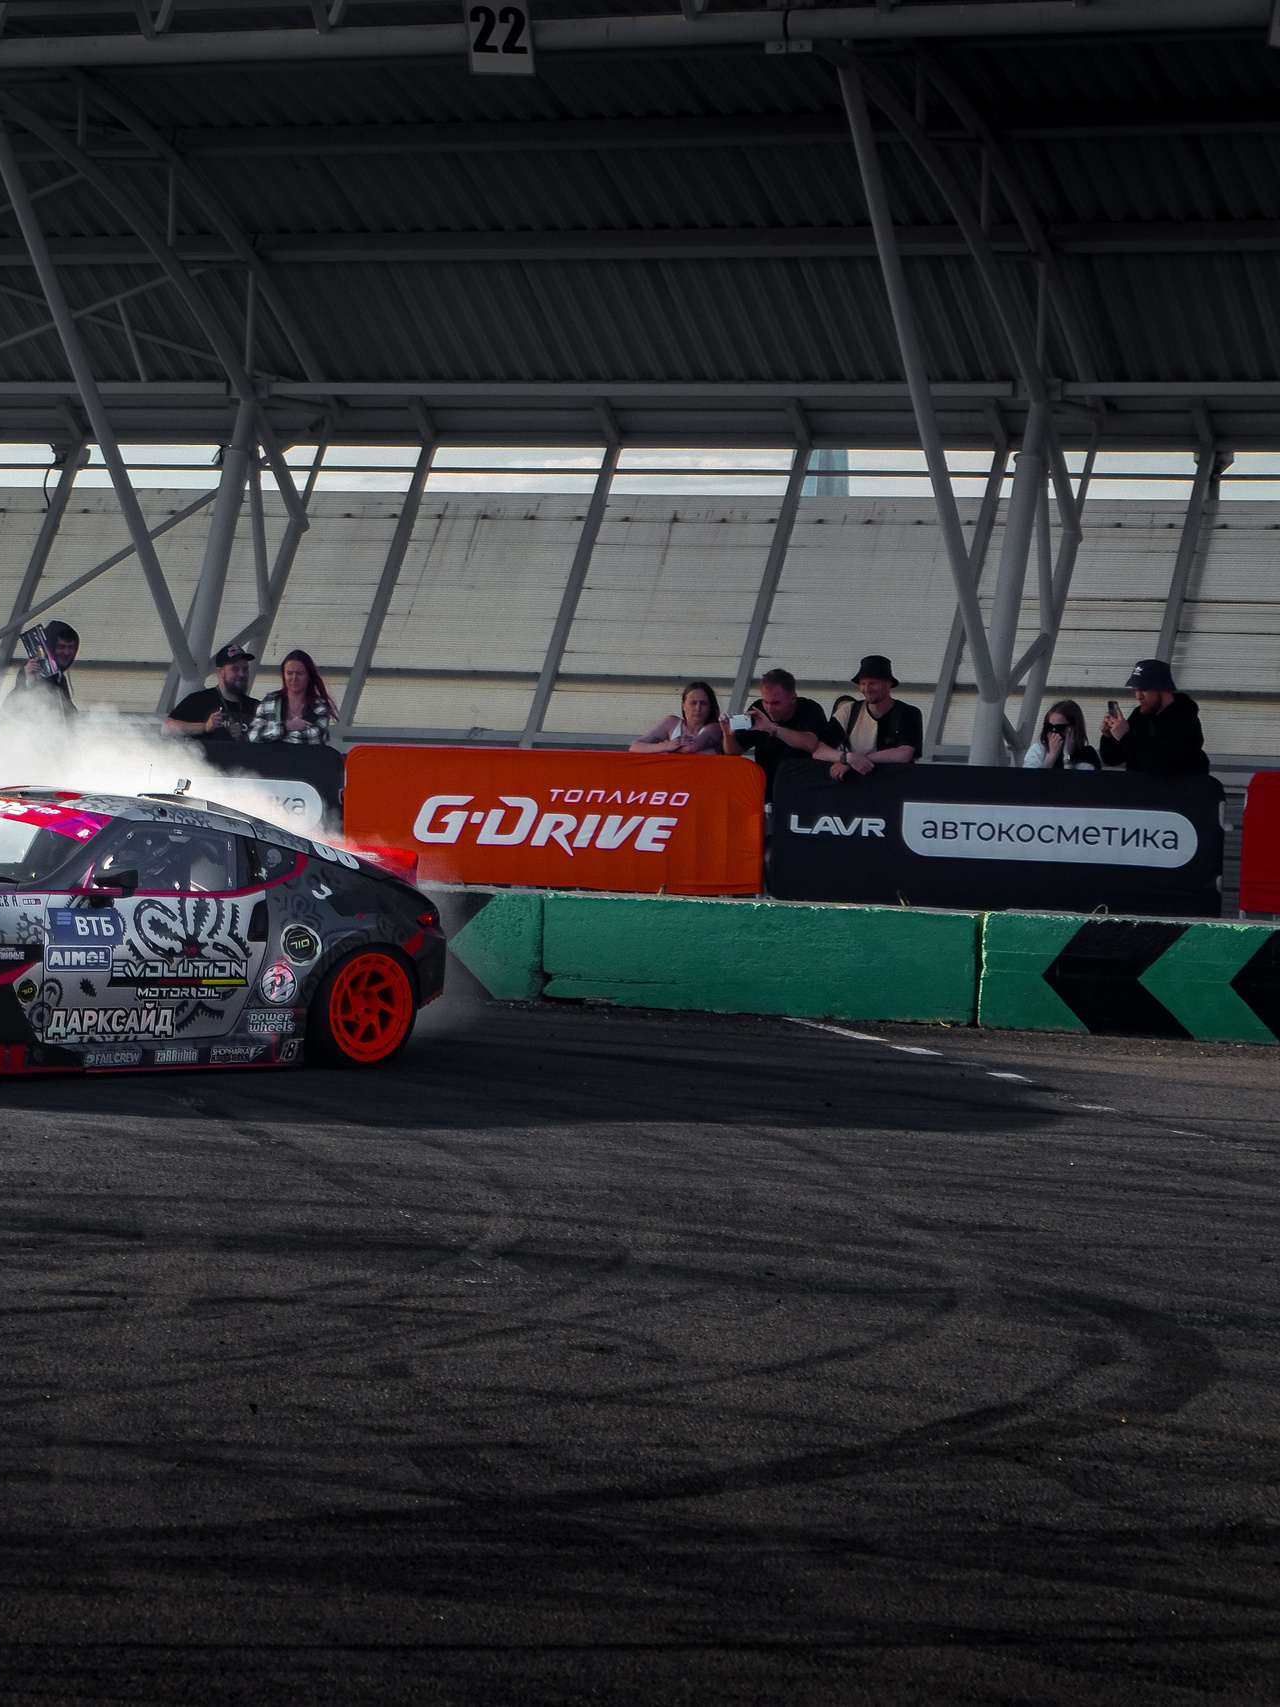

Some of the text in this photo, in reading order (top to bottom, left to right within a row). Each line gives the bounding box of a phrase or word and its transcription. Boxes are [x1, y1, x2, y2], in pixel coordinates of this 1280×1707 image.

[470, 6, 528, 54] 22
[550, 789, 690, 807] ТОПЛИВО
[790, 813, 886, 838] LAVR
[921, 817, 1179, 851] автокосметика
[74, 916, 115, 937] ВТБ
[49, 951, 109, 967] AIMOL
[112, 961, 247, 978] EVOLUTION
[137, 988, 190, 998] MOTOR
[47, 1002, 174, 1038] ДАРКСАЙД
[249, 1012, 293, 1024] power
[249, 1021, 294, 1033] wheels
